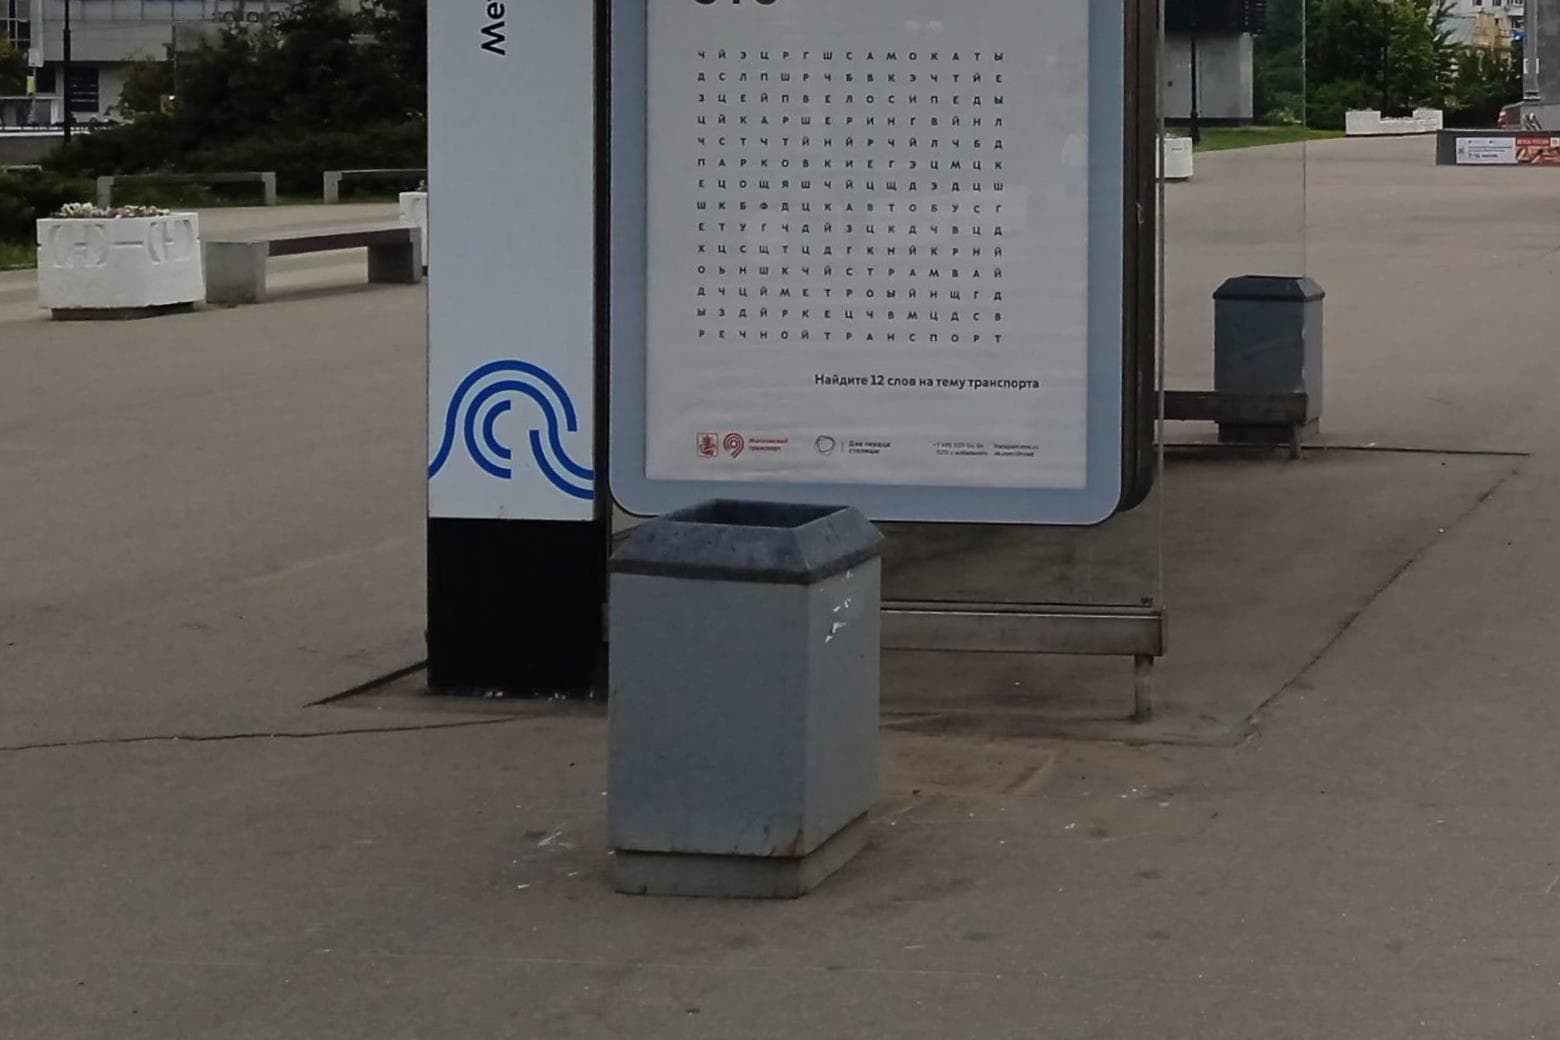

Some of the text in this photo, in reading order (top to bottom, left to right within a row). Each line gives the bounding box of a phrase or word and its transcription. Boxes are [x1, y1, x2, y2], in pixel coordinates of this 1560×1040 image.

[815, 373, 1040, 392] Найдите 12 слов на тему транспорта
